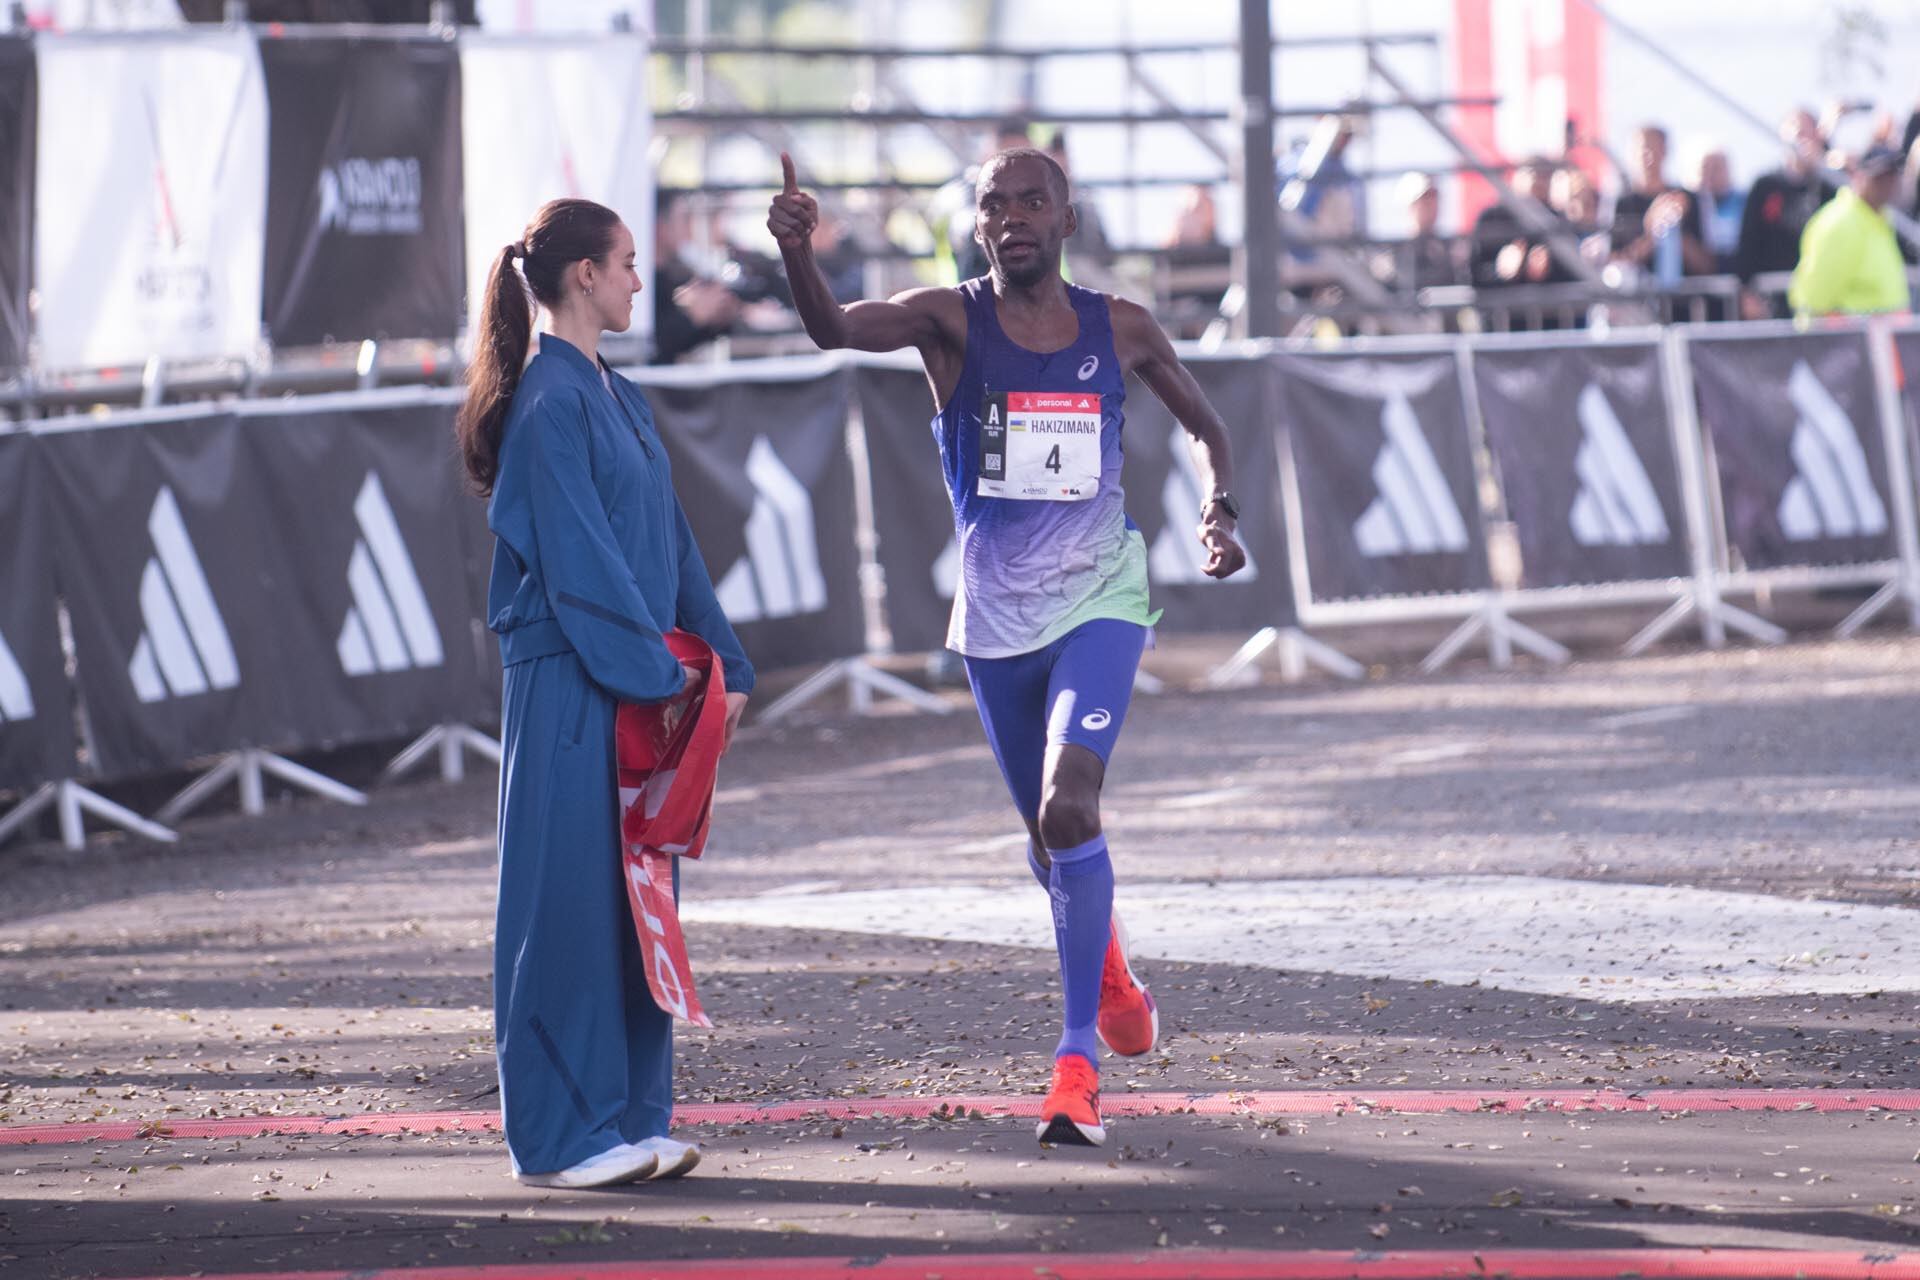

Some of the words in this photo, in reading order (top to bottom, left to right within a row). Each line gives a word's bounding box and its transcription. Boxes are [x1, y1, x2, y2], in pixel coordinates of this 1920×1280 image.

[1037, 399, 1072, 408] personal
[989, 403, 1000, 425] A
[1031, 420, 1096, 434] HAKIZIMANA
[1045, 444, 1061, 474] 4
